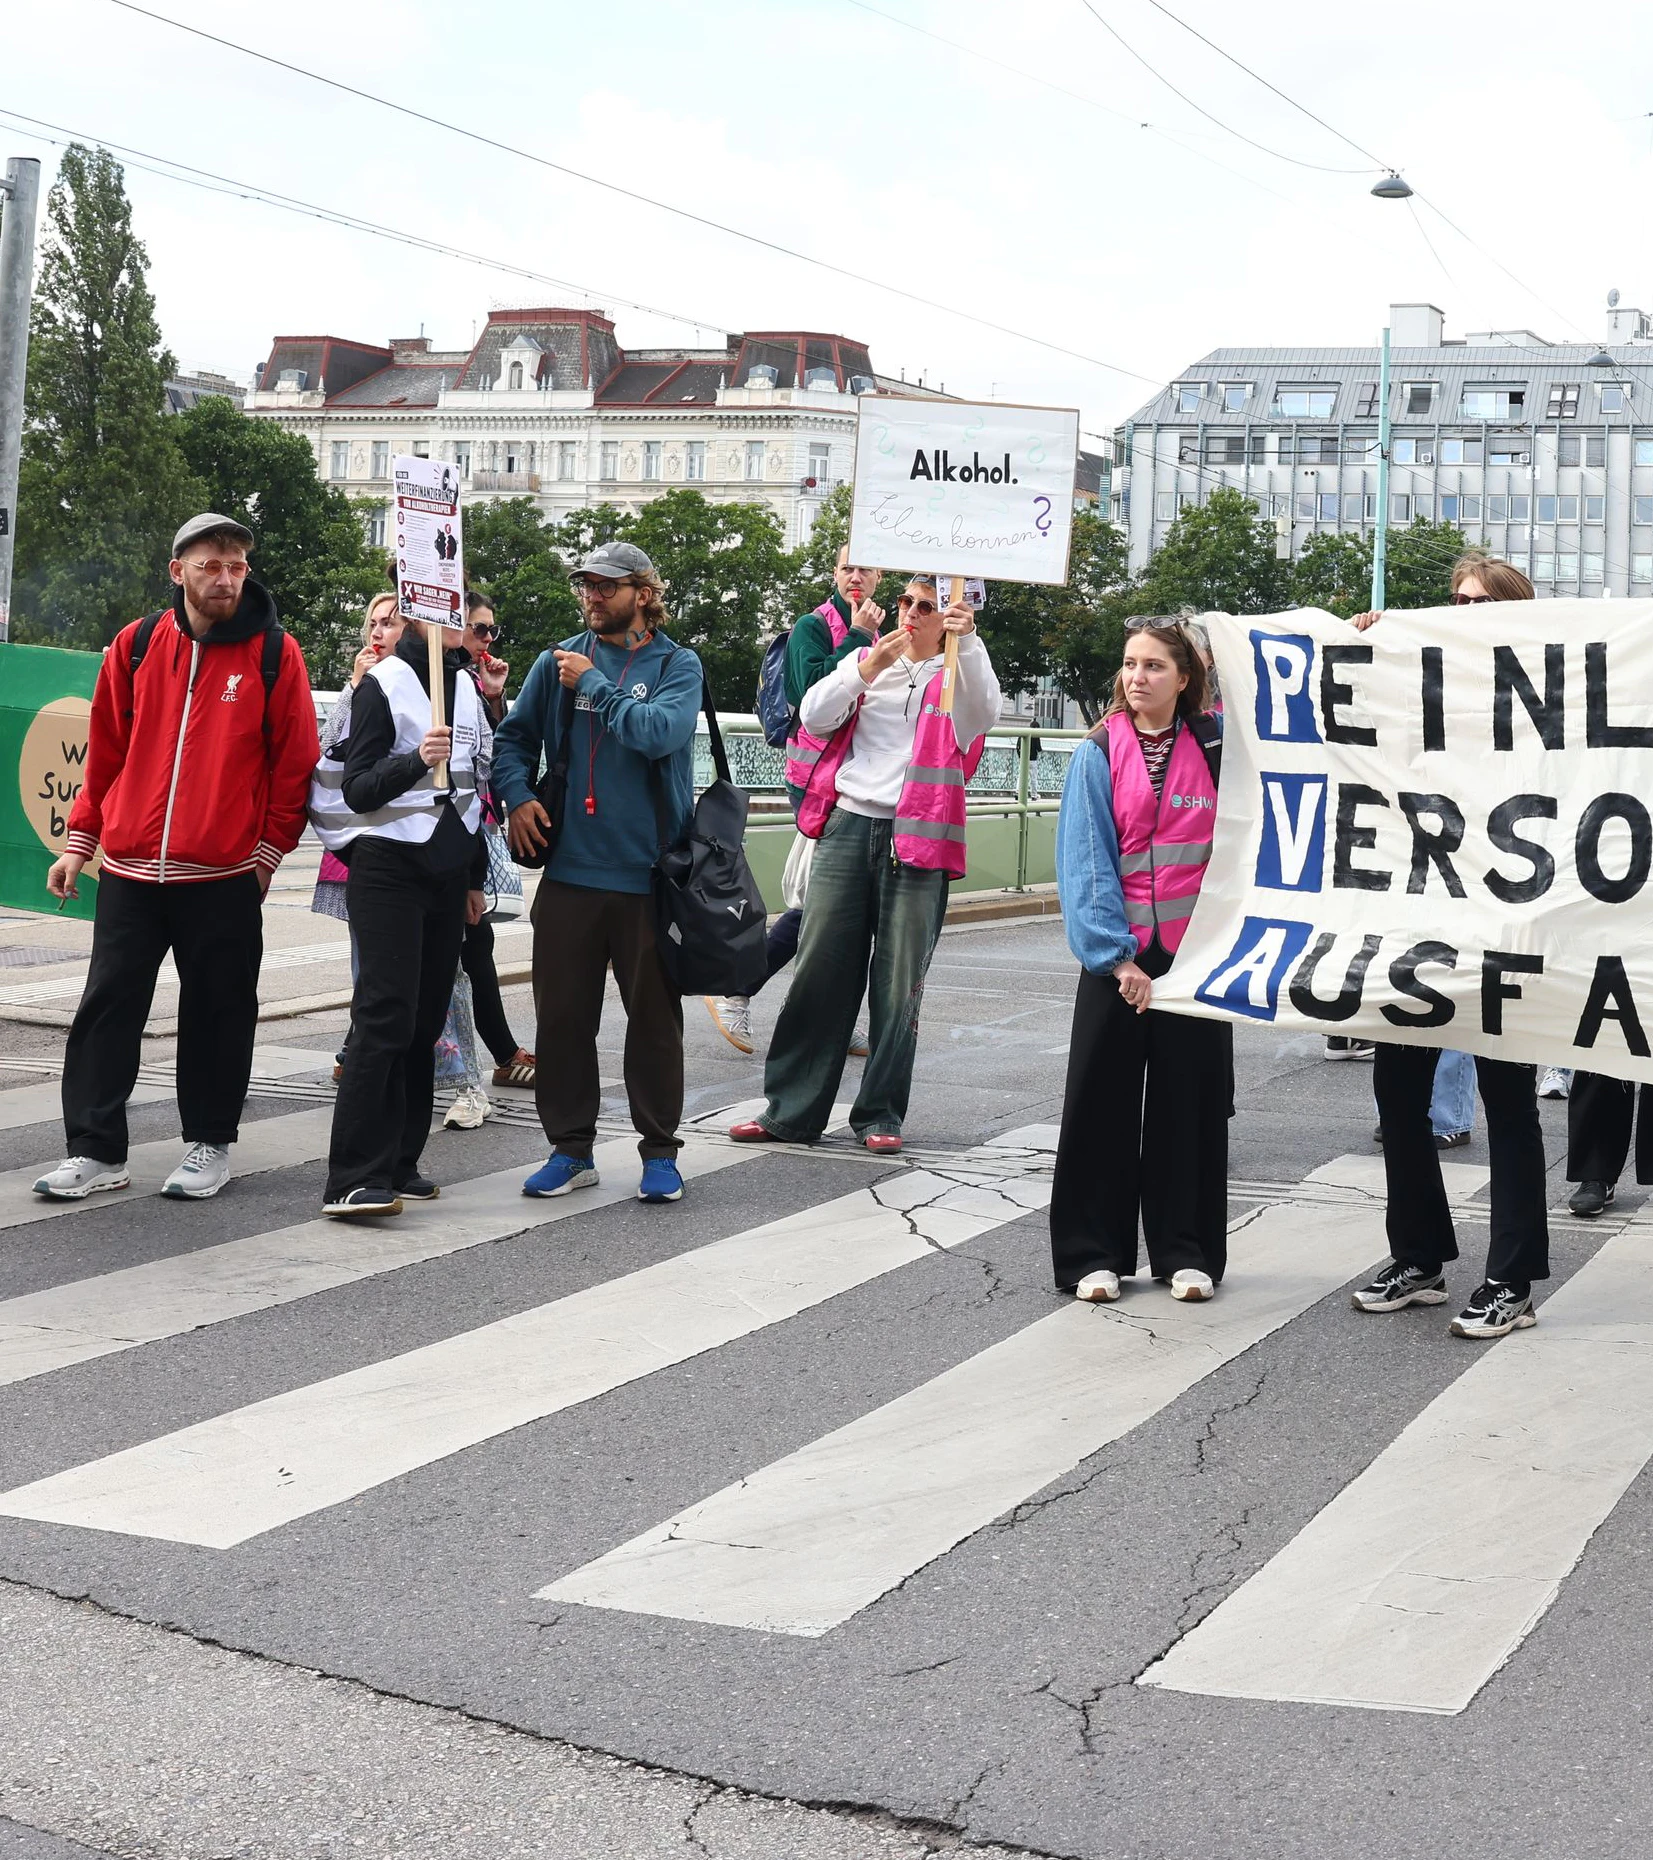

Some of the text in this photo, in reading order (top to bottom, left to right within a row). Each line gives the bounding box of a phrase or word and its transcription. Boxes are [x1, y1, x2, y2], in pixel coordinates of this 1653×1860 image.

[909, 449, 1018, 485] Alkohol.
[869, 493, 942, 548] Leben
[1184, 795, 1214, 810] SHW
